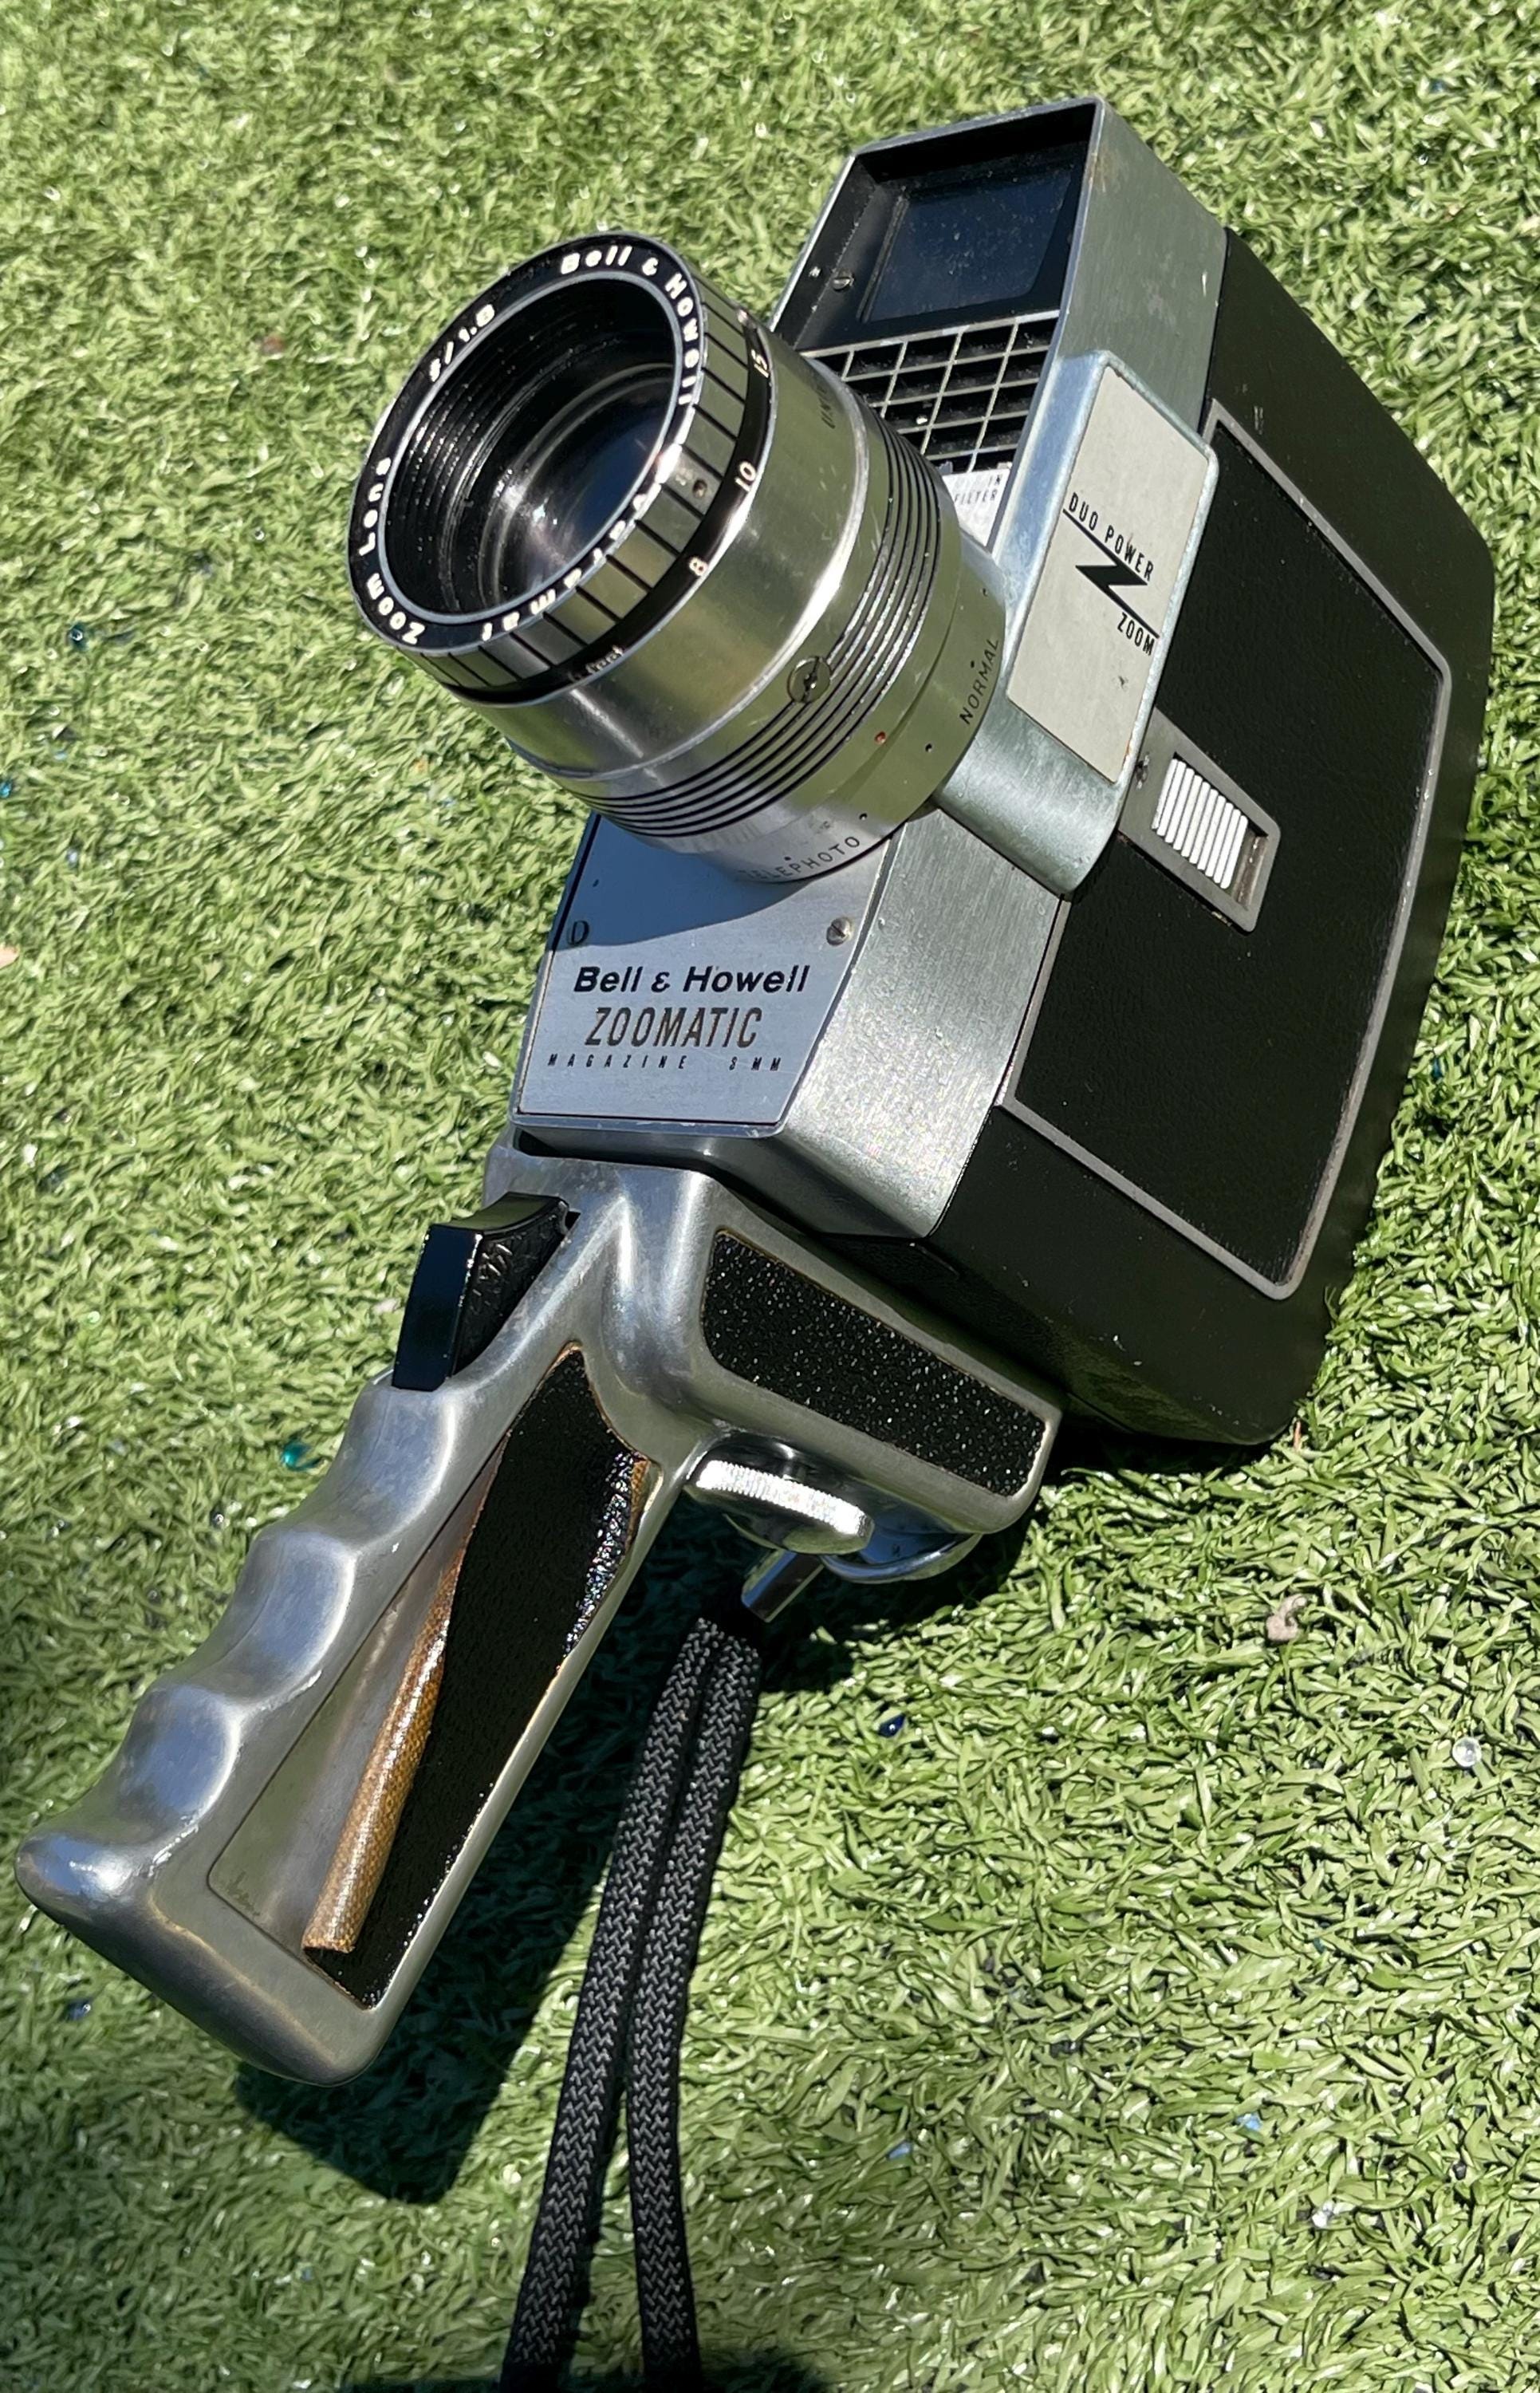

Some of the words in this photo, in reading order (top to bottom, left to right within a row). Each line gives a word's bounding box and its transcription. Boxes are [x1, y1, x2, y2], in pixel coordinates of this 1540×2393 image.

[561, 245, 633, 275] Bell
[664, 272, 701, 406] Howell
[734, 459, 758, 493] 10
[358, 456, 392, 557] Lens
[1068, 491, 1099, 531] DUO
[1105, 524, 1154, 581] POWER
[688, 556, 709, 577] 8
[1117, 611, 1156, 656] ZOOM
[959, 638, 999, 726] NORMAL
[573, 965, 644, 993] Bell
[650, 971, 672, 993] &
[682, 964, 811, 994] Howell
[584, 1007, 763, 1049] ZOOMATIC
[547, 1052, 687, 1070] MAGAZINE
